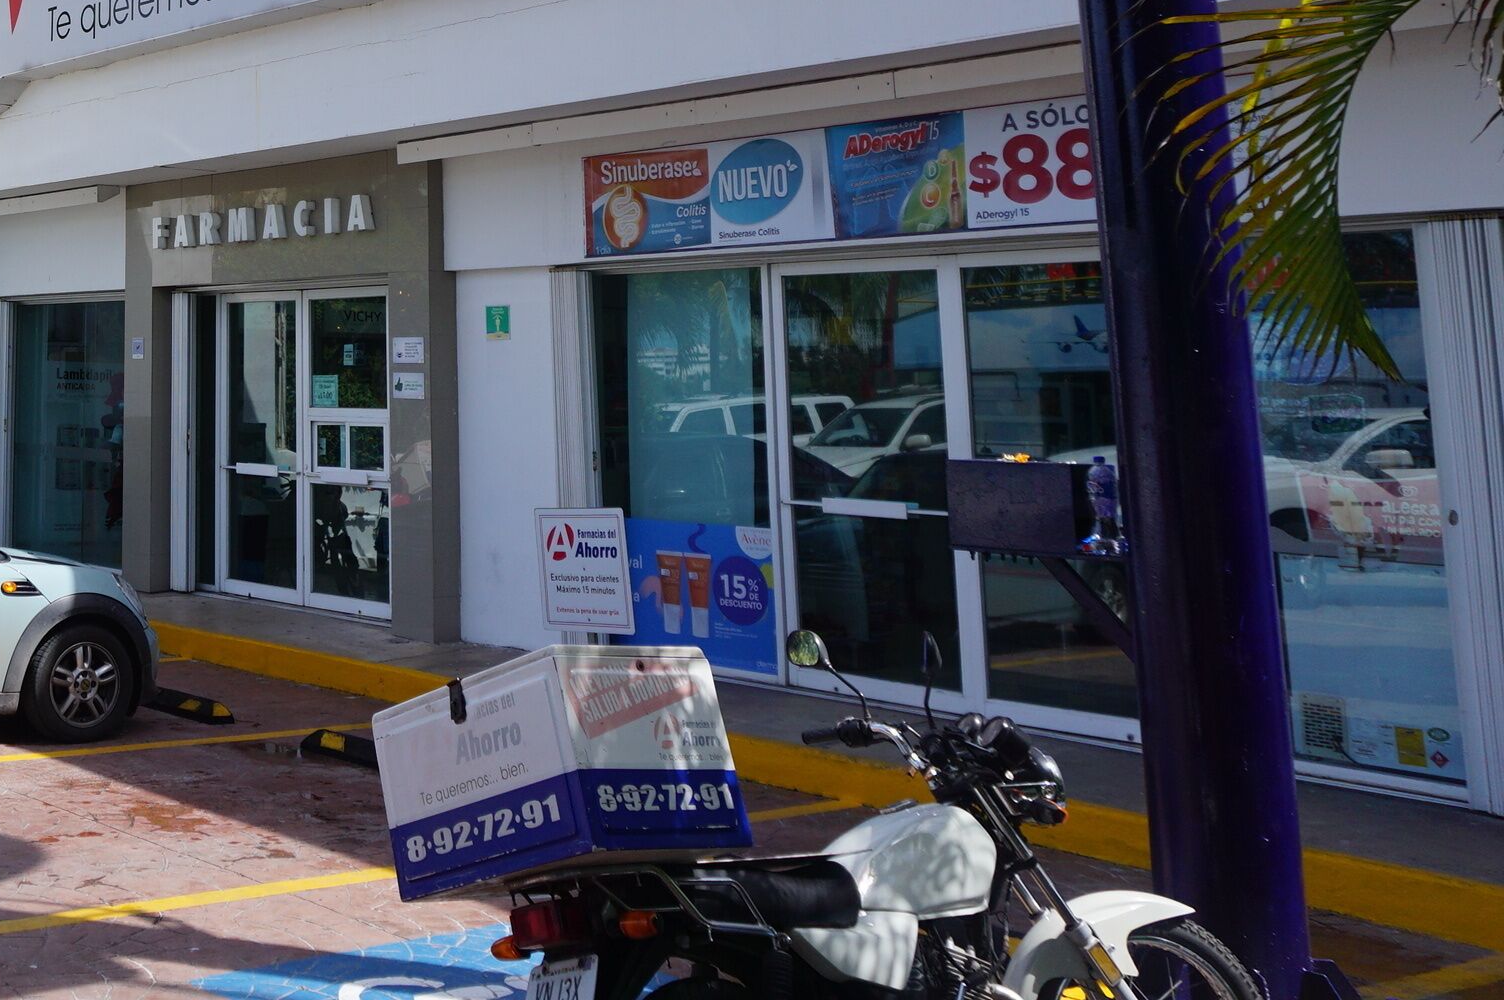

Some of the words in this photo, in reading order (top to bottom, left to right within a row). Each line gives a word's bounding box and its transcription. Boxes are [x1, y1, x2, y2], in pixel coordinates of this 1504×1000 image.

[48, 6, 71, 41] Te
[1002, 113, 1018, 132] A
[1026, 103, 1089, 127] SÓLO
[843, 122, 928, 160] ADerogyl
[928, 121, 939, 140] 15
[601, 158, 692, 185] Sinuberase
[718, 163, 788, 203] NUEVO
[676, 204, 706, 217] Colitis
[976, 208, 1018, 219] ADerogyl
[1020, 207, 1030, 216] 15
[151, 195, 376, 250] FARMACIA
[719, 229, 756, 239] Sinuberase
[758, 227, 780, 236] Colitis
[344, 311, 382, 322] VICHY
[577, 529, 606, 539] Farmacias
[607, 530, 616, 539] del
[575, 542, 617, 558] Ahorro
[550, 573, 579, 582] Exclusivo
[581, 575, 594, 584] para
[596, 575, 619, 583] clientes
[583, 586, 590, 594] 15
[591, 587, 616, 595] minutos
[749, 593, 759, 601] DE
[720, 598, 763, 610] DESCUENTO
[580, 690, 622, 724] SALUD
[619, 689, 632, 709] A
[456, 721, 522, 765] Ahorro
[420, 791, 433, 806] Te
